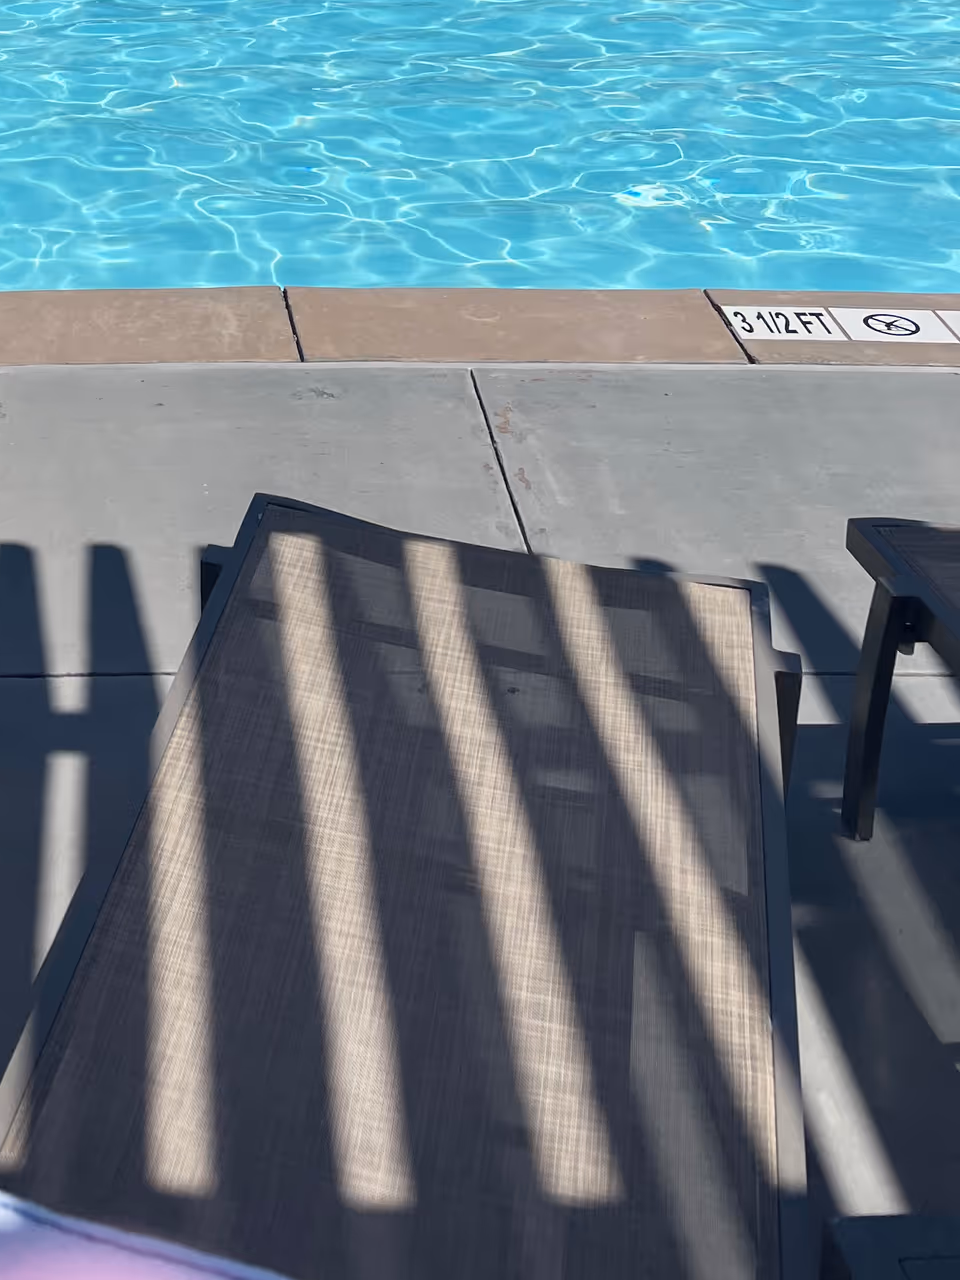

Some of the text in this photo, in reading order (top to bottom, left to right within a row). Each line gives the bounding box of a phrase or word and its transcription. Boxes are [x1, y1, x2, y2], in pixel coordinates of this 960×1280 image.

[733, 311, 833, 335] 3 1/2 FT
